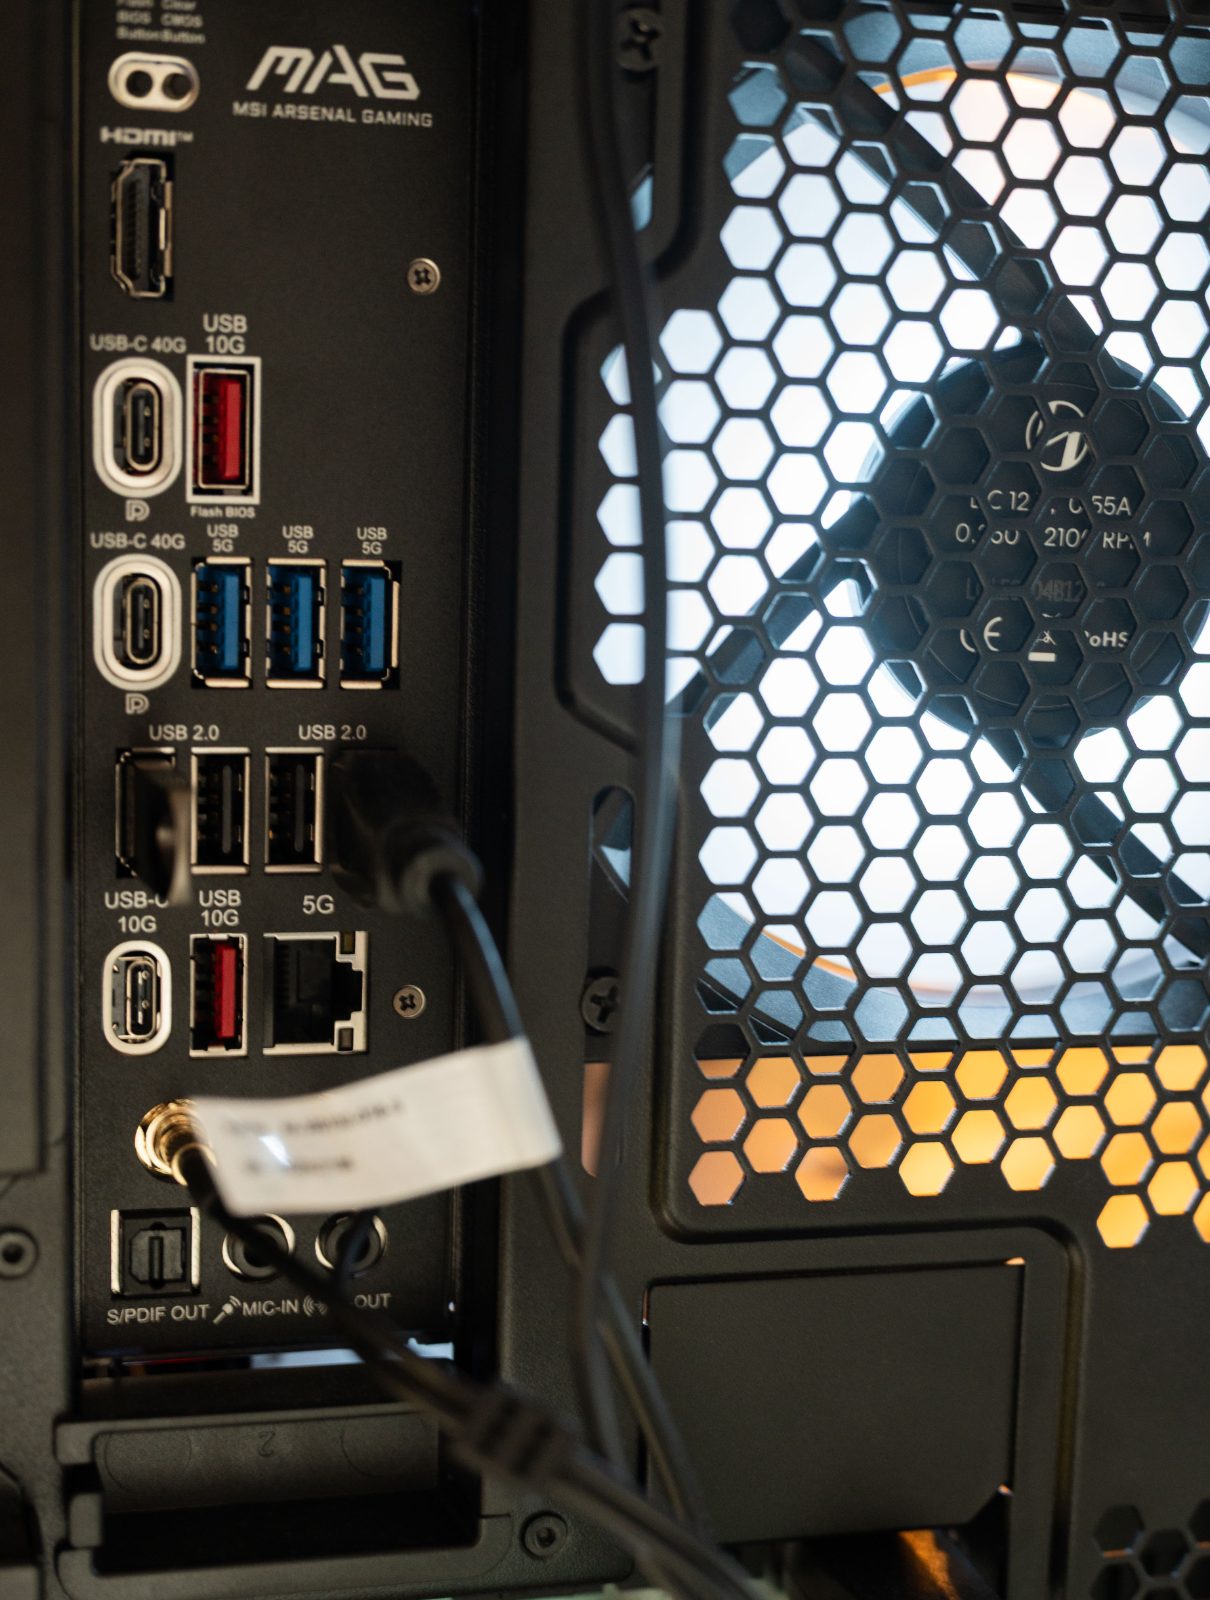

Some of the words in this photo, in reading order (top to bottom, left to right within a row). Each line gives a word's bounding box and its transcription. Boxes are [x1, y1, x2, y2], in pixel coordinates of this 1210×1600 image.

[116, 10, 152, 25] BIOS
[161, 12, 203, 29] CMOS
[246, 44, 421, 101] MAG
[232, 101, 267, 118] MSI
[272, 104, 356, 124] ARSENAL
[361, 109, 434, 128] GAMING
[202, 313, 248, 334] USB
[89, 334, 148, 352] USB-C
[150, 336, 187, 354] 40G
[205, 335, 246, 355] 10G
[190, 505, 223, 519] Flash
[225, 506, 256, 519] BIOS
[206, 524, 239, 539] USB
[282, 525, 314, 541] USB
[356, 527, 388, 542] USB
[89, 532, 148, 550] USB-C
[150, 533, 187, 551] 40G
[212, 539, 234, 553] 5G
[287, 540, 309, 555] 5G
[361, 542, 383, 556] 5G
[148, 724, 188, 741] USB
[192, 725, 220, 741] 2.0
[297, 724, 336, 741] USB
[340, 725, 368, 741] 2.0
[198, 889, 242, 908] USB
[301, 894, 336, 915] 5G
[118, 914, 158, 934] 10G
[200, 908, 240, 927] 10G
[242, 1299, 299, 1317] MIC-IN
[353, 1292, 392, 1310] OUT
[106, 1306, 167, 1326] S/PDIF
[170, 1303, 210, 1322] OUT
